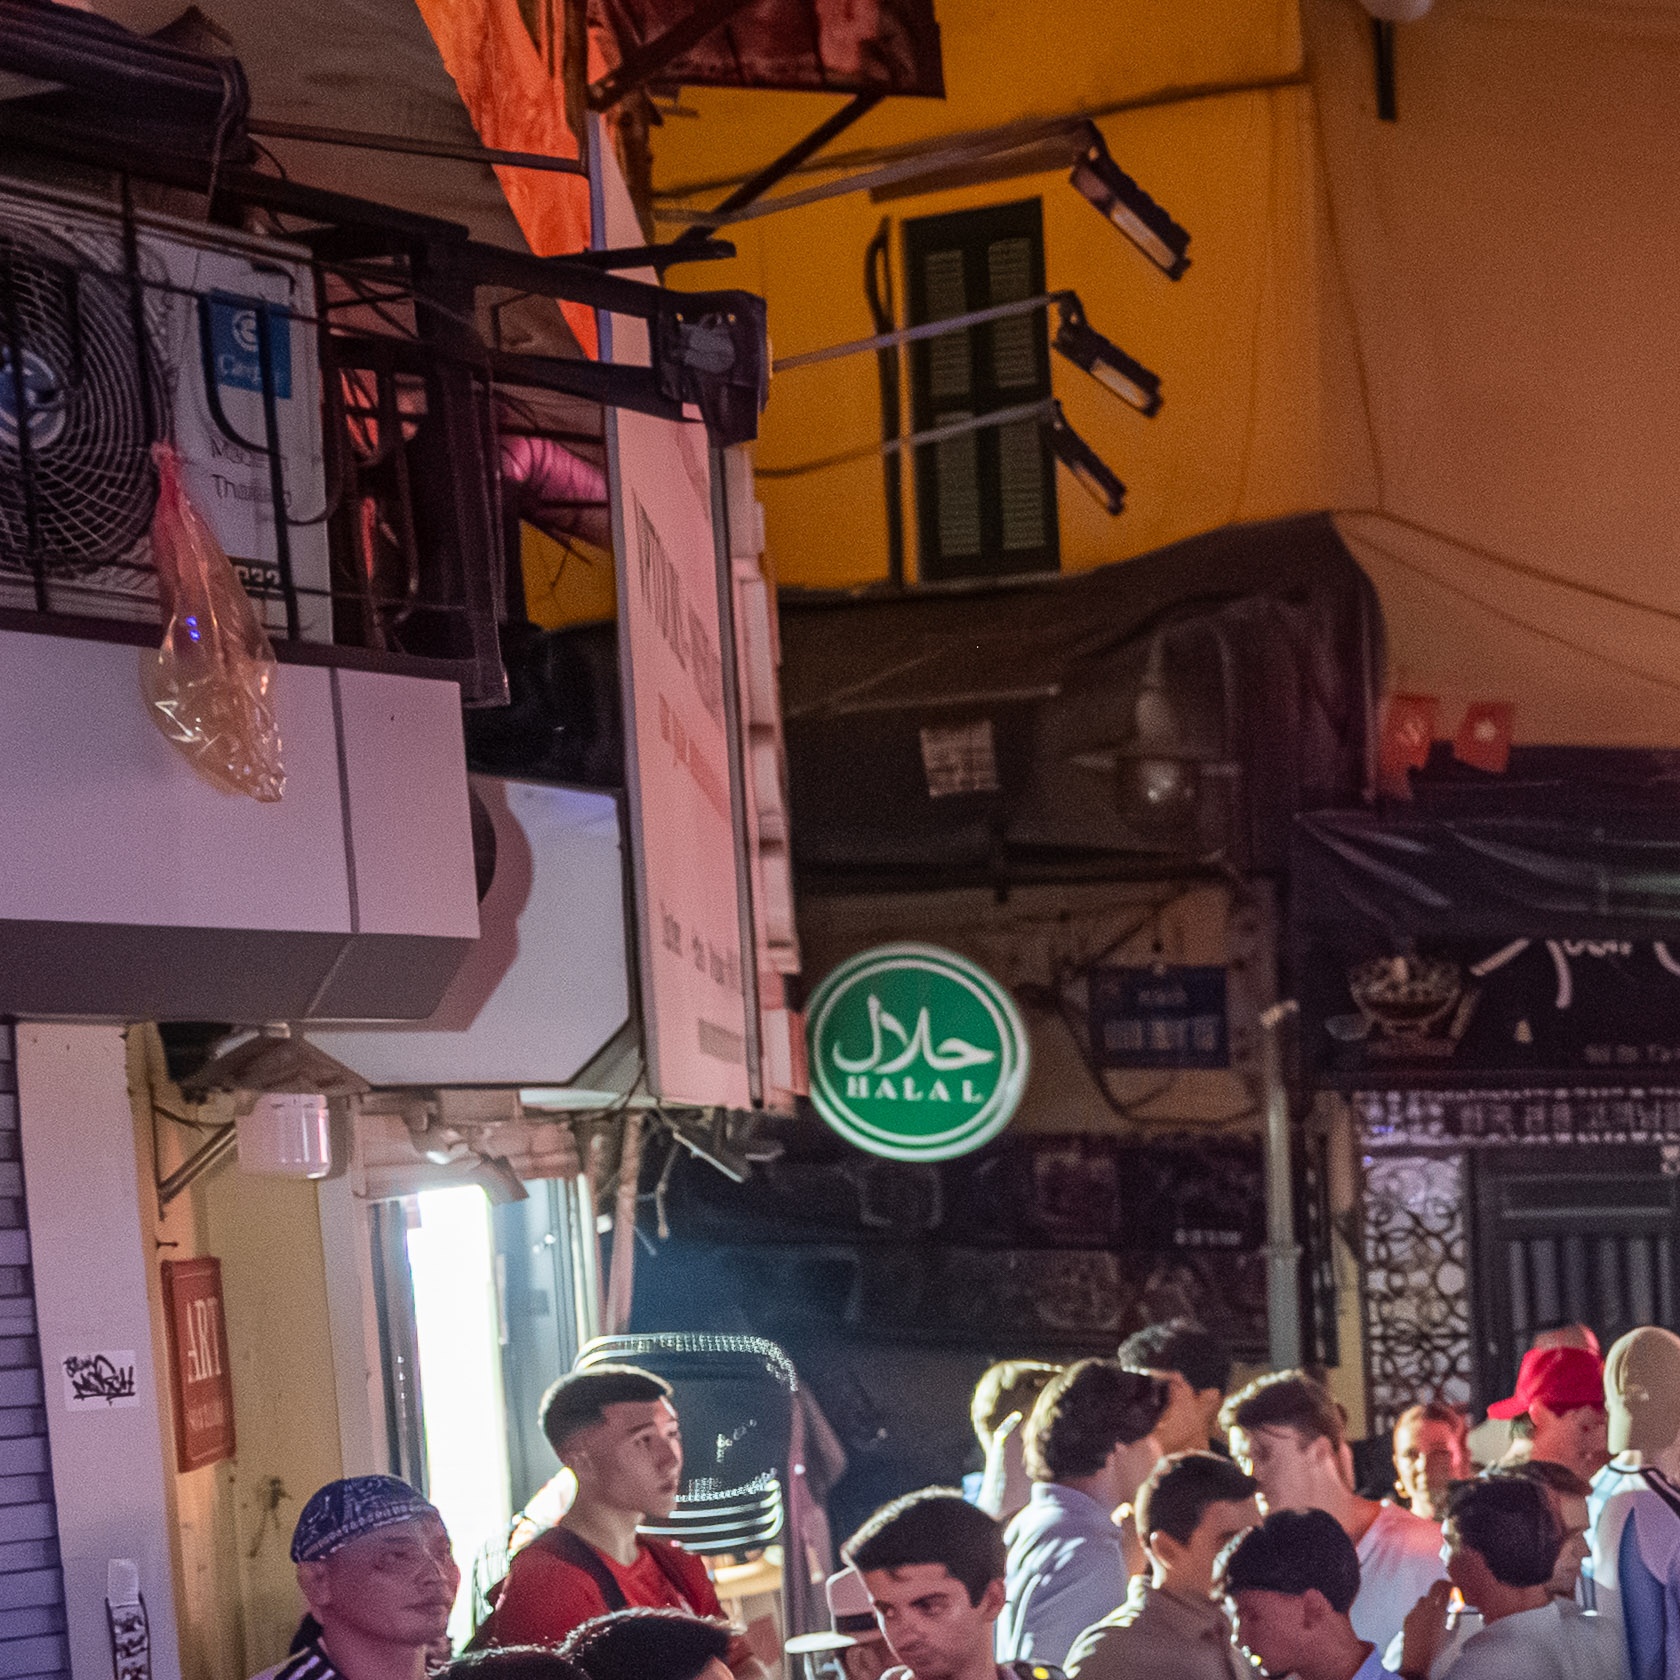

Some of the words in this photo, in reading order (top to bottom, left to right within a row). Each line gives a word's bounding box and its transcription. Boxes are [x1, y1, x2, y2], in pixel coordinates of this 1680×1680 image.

[832, 993, 995, 1075] حلال
[846, 1075, 985, 1103] HALAL
[186, 1296, 221, 1384] ART
